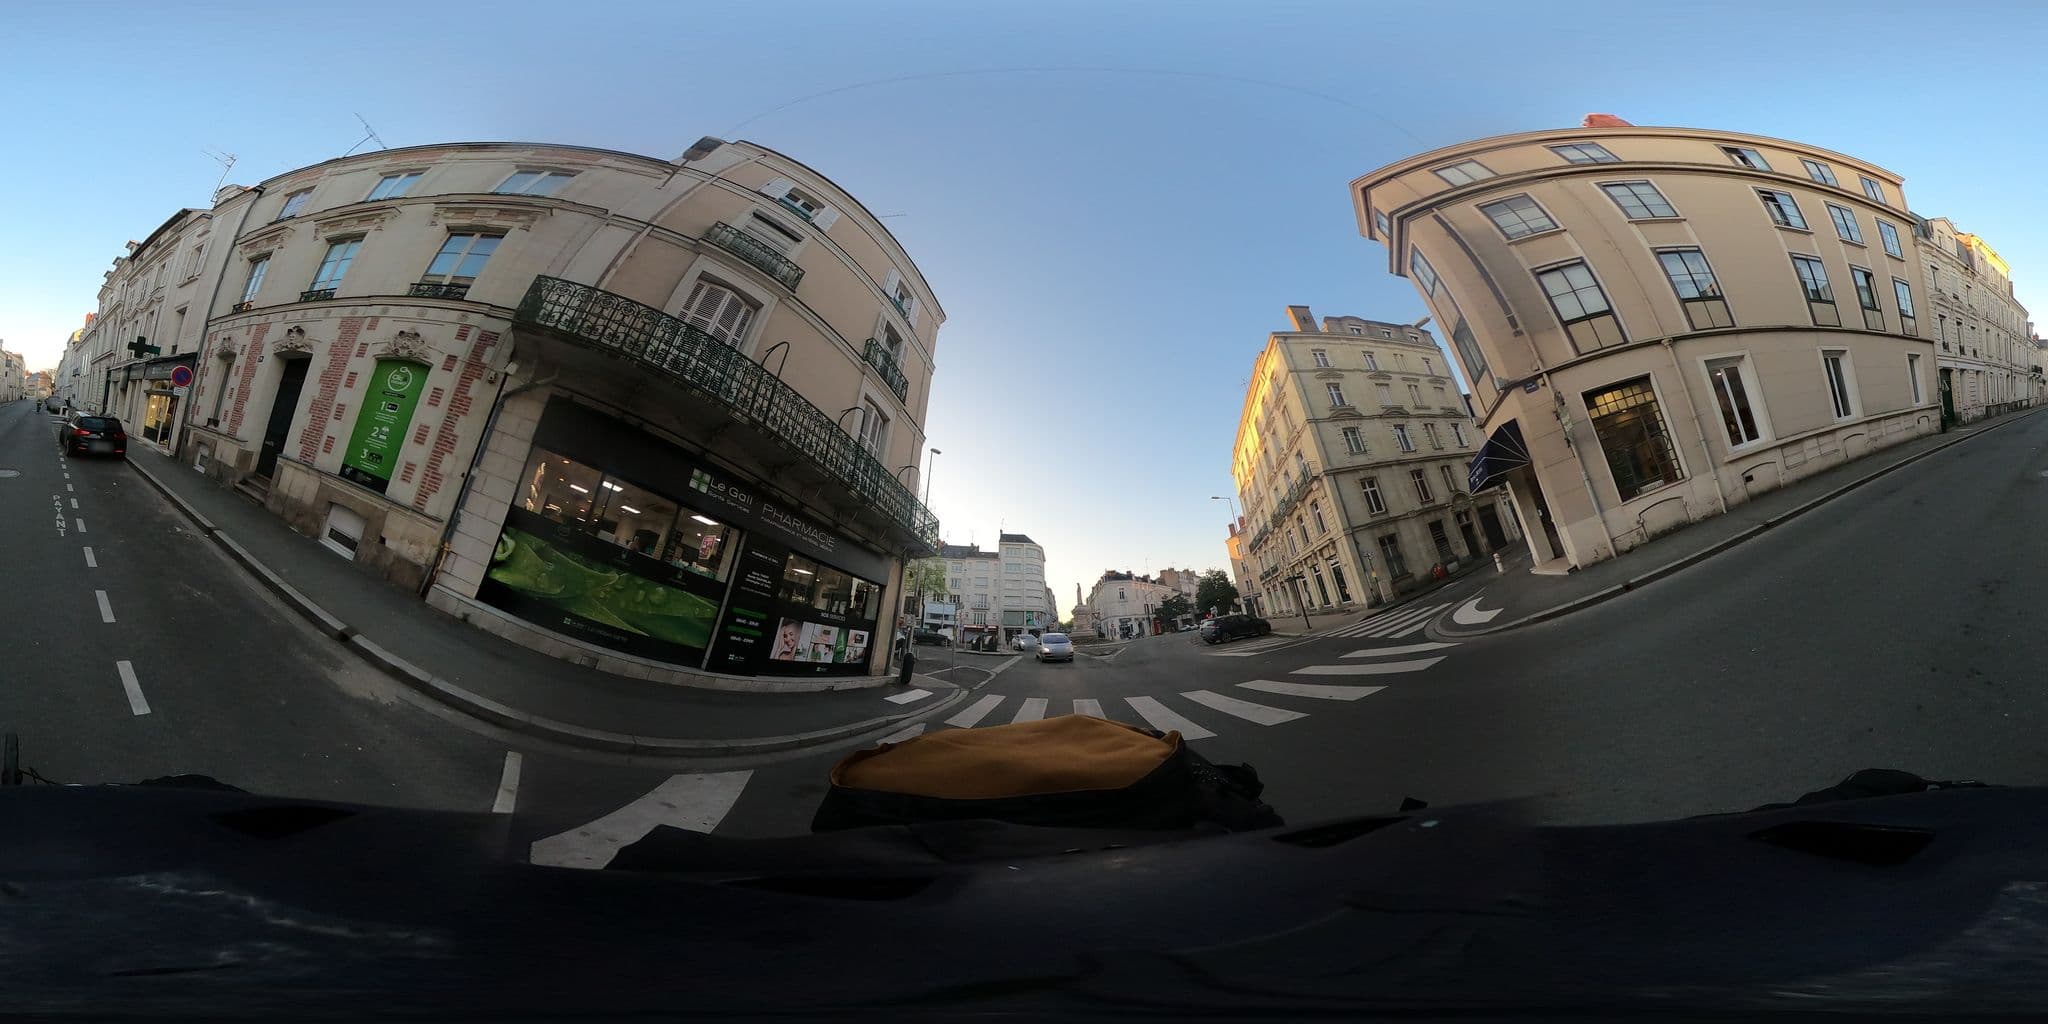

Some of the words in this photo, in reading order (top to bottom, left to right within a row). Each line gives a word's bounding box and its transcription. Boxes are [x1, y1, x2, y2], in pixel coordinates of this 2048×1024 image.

[380, 401, 386, 411] 1
[371, 427, 379, 437] 2
[361, 449, 368, 459] 3
[710, 477, 726, 492] Le
[728, 487, 753, 505] Gall
[53, 495, 66, 537] PAYANT
[762, 503, 836, 547] PHARMACIE
